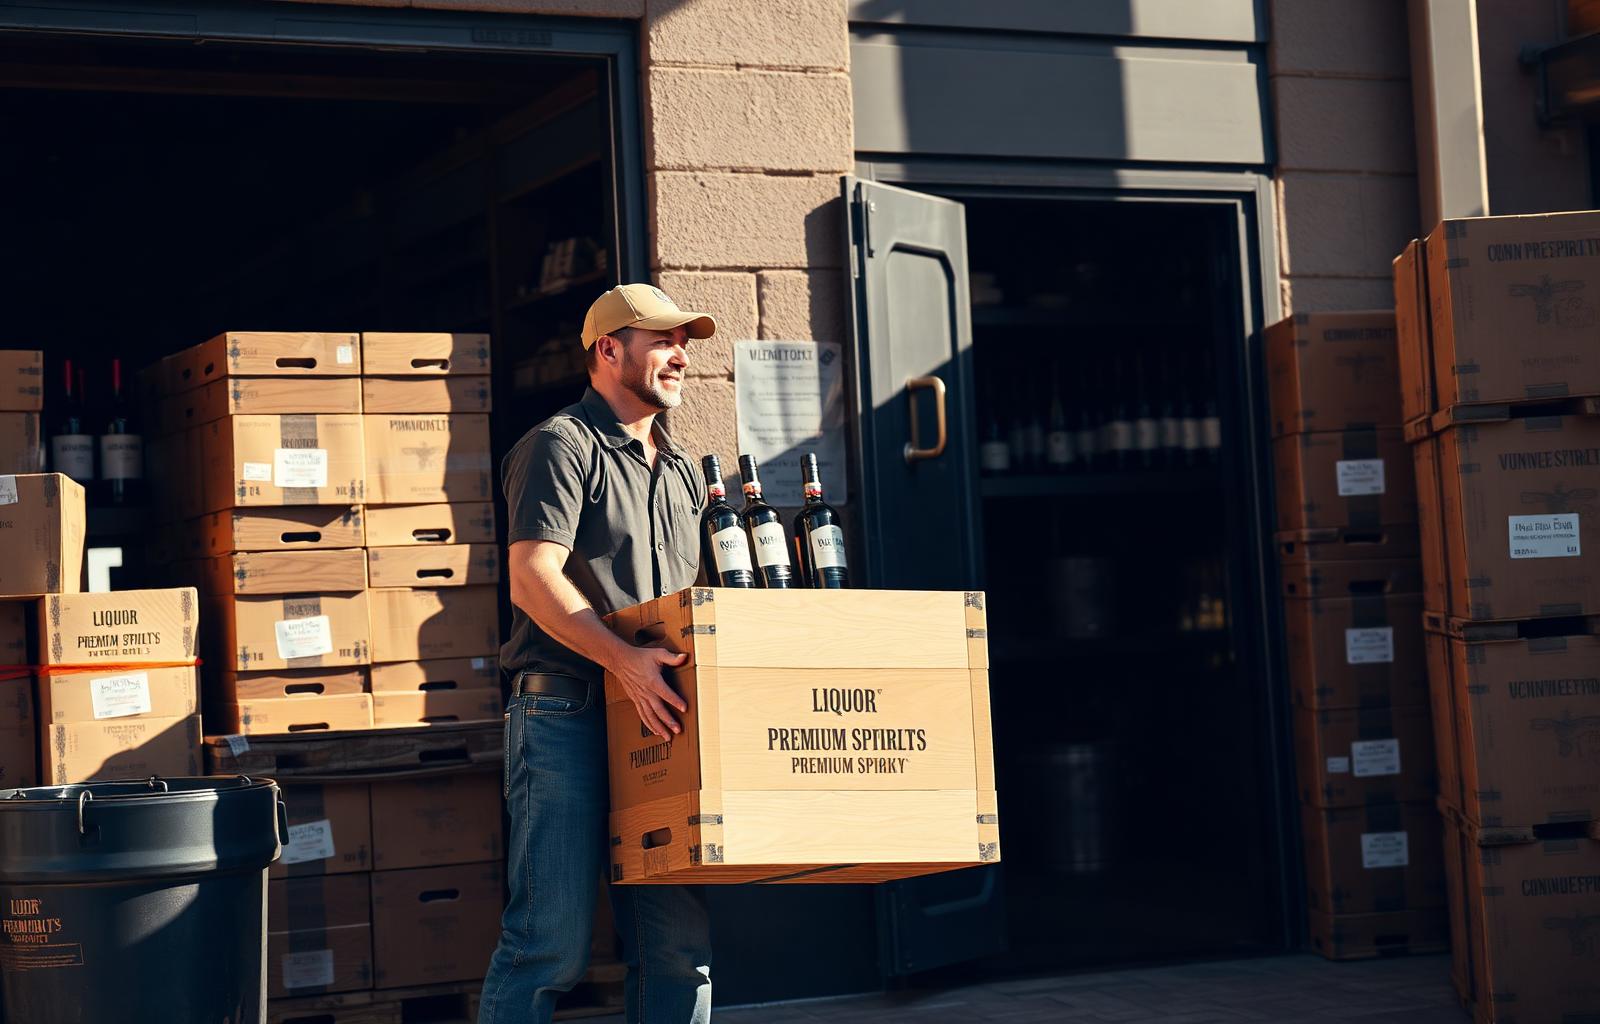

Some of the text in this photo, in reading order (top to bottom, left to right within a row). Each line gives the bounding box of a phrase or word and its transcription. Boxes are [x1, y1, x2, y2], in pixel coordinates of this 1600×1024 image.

[93, 609, 138, 627] LIQUOR
[812, 688, 877, 716] LIQUOR
[767, 728, 847, 751] PREMIUM
[791, 757, 853, 774] PREMIUM
